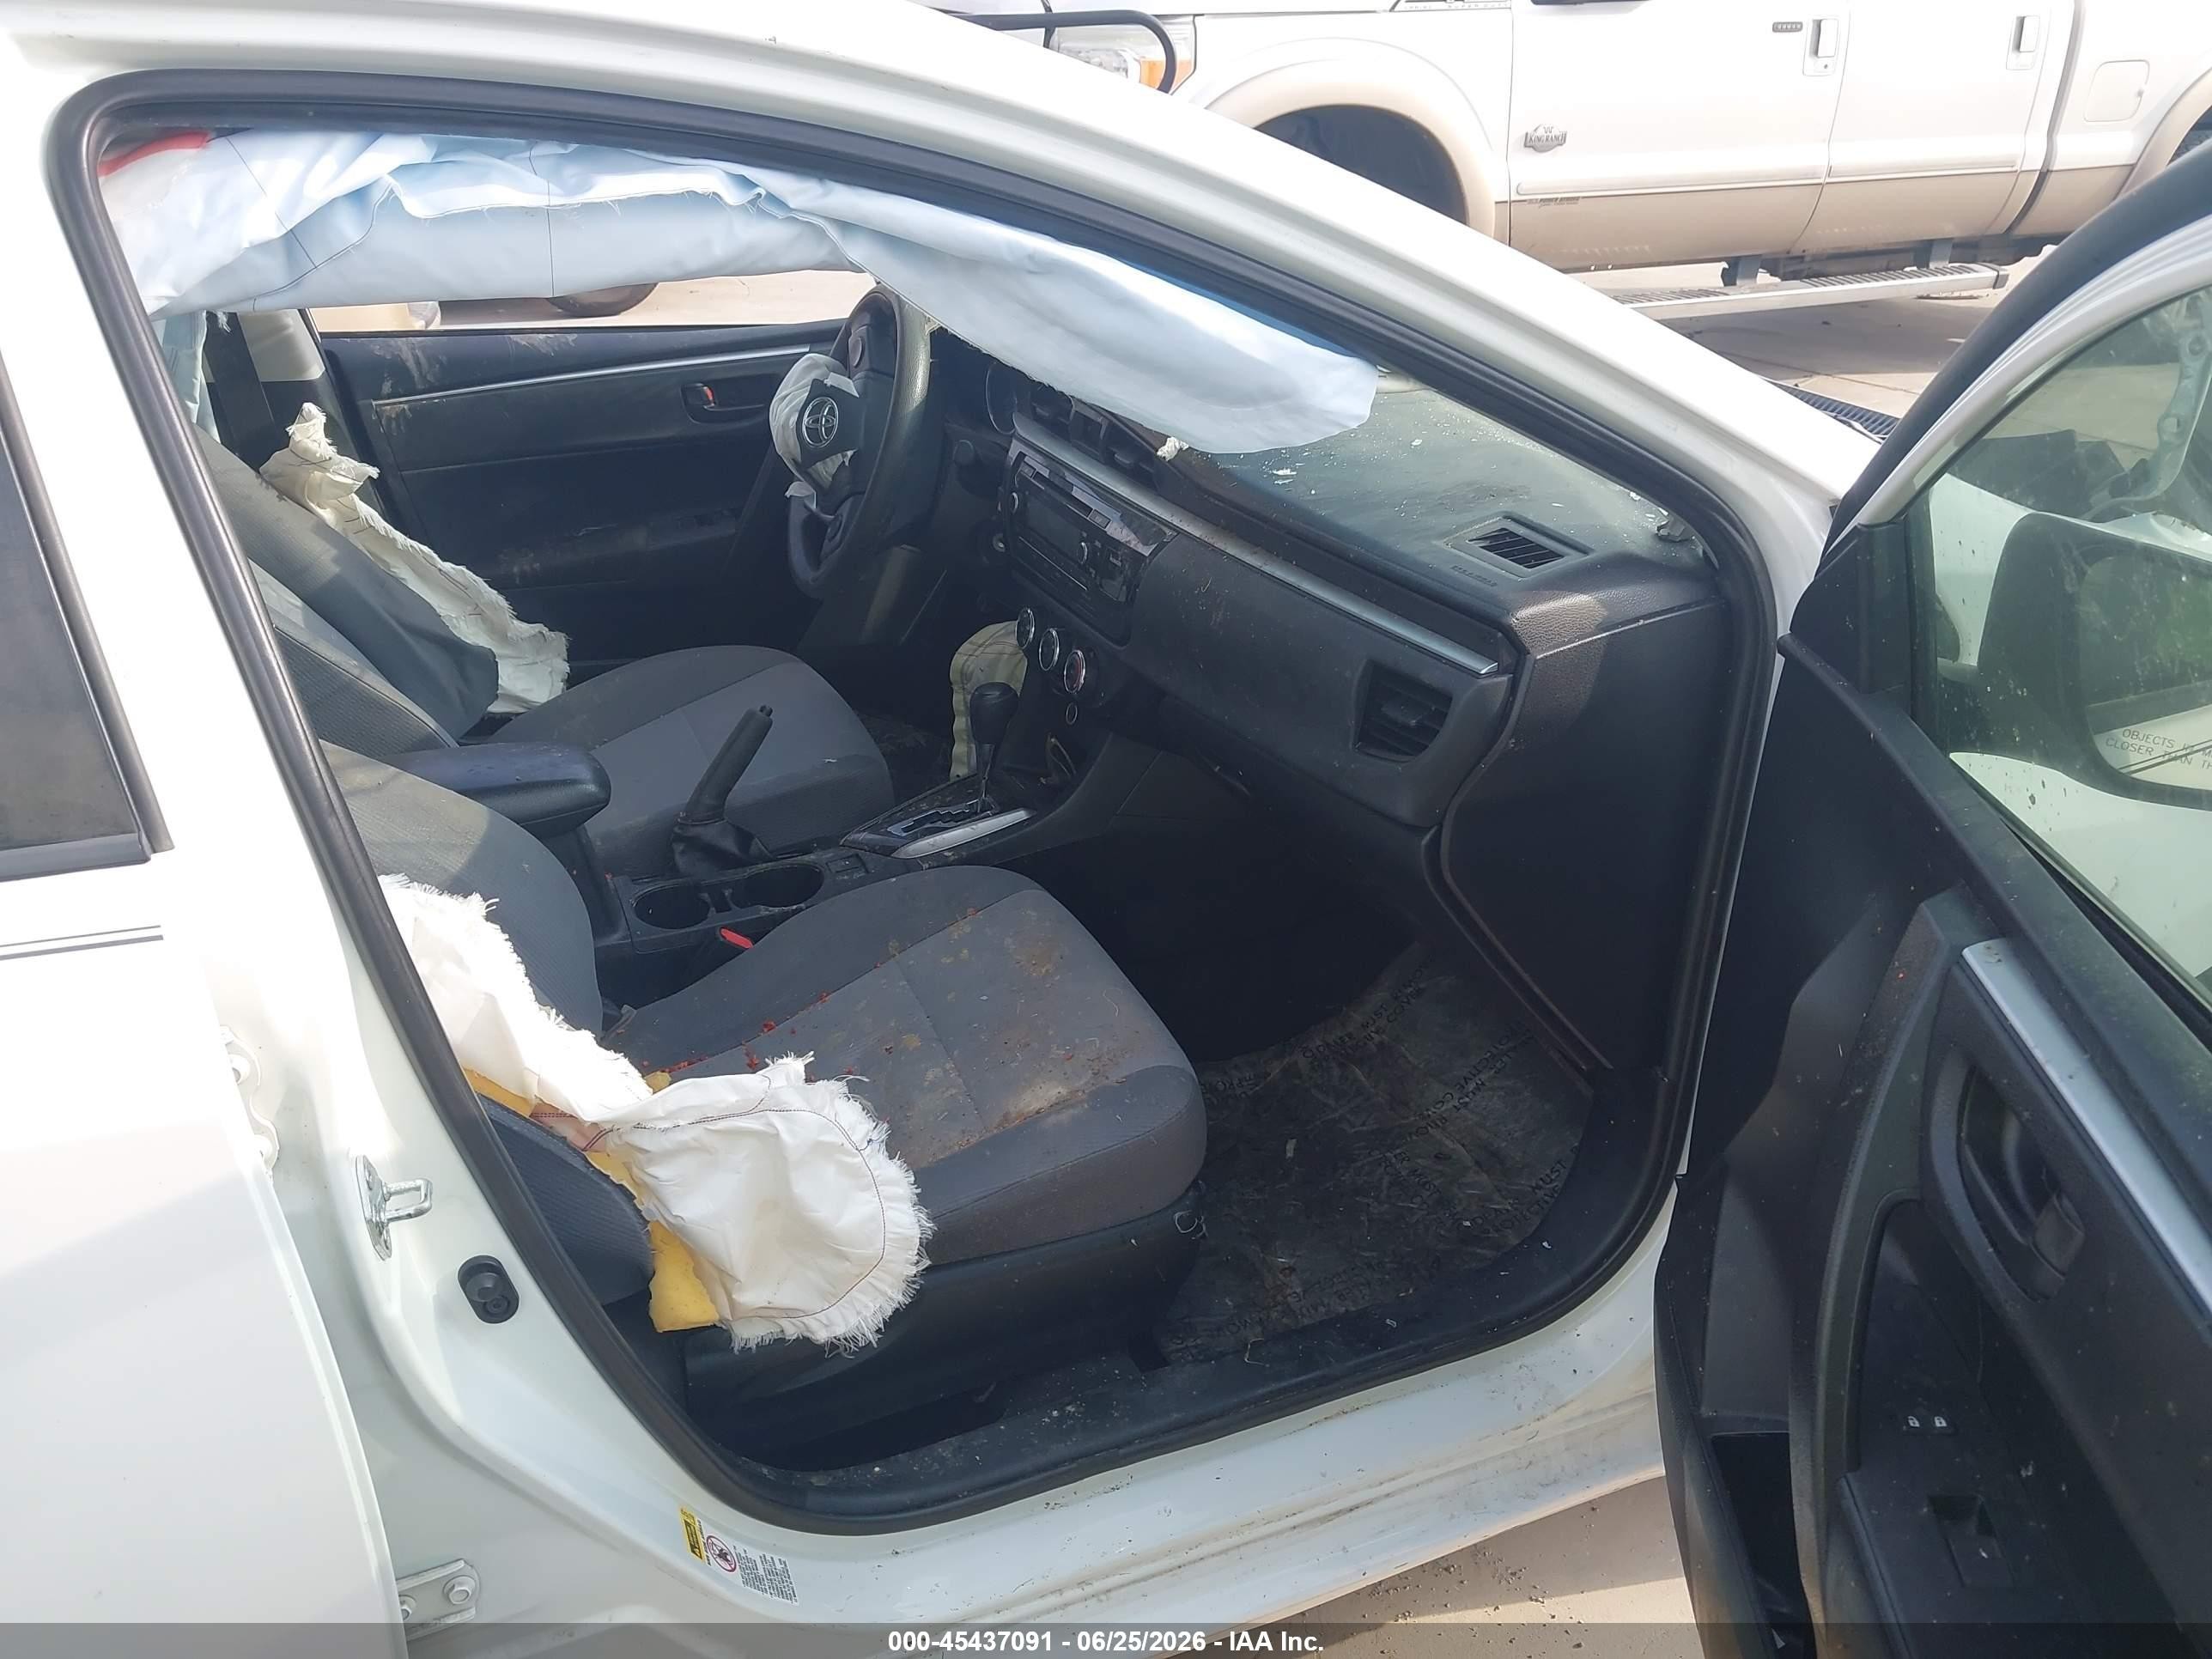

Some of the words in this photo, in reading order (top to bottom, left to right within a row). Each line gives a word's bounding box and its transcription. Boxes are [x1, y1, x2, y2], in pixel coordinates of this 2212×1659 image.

[2105, 737, 2154, 757] CLOSER
[2122, 728, 2176, 749] OBJECTS
[1531, 1159, 1567, 1196] MUST
